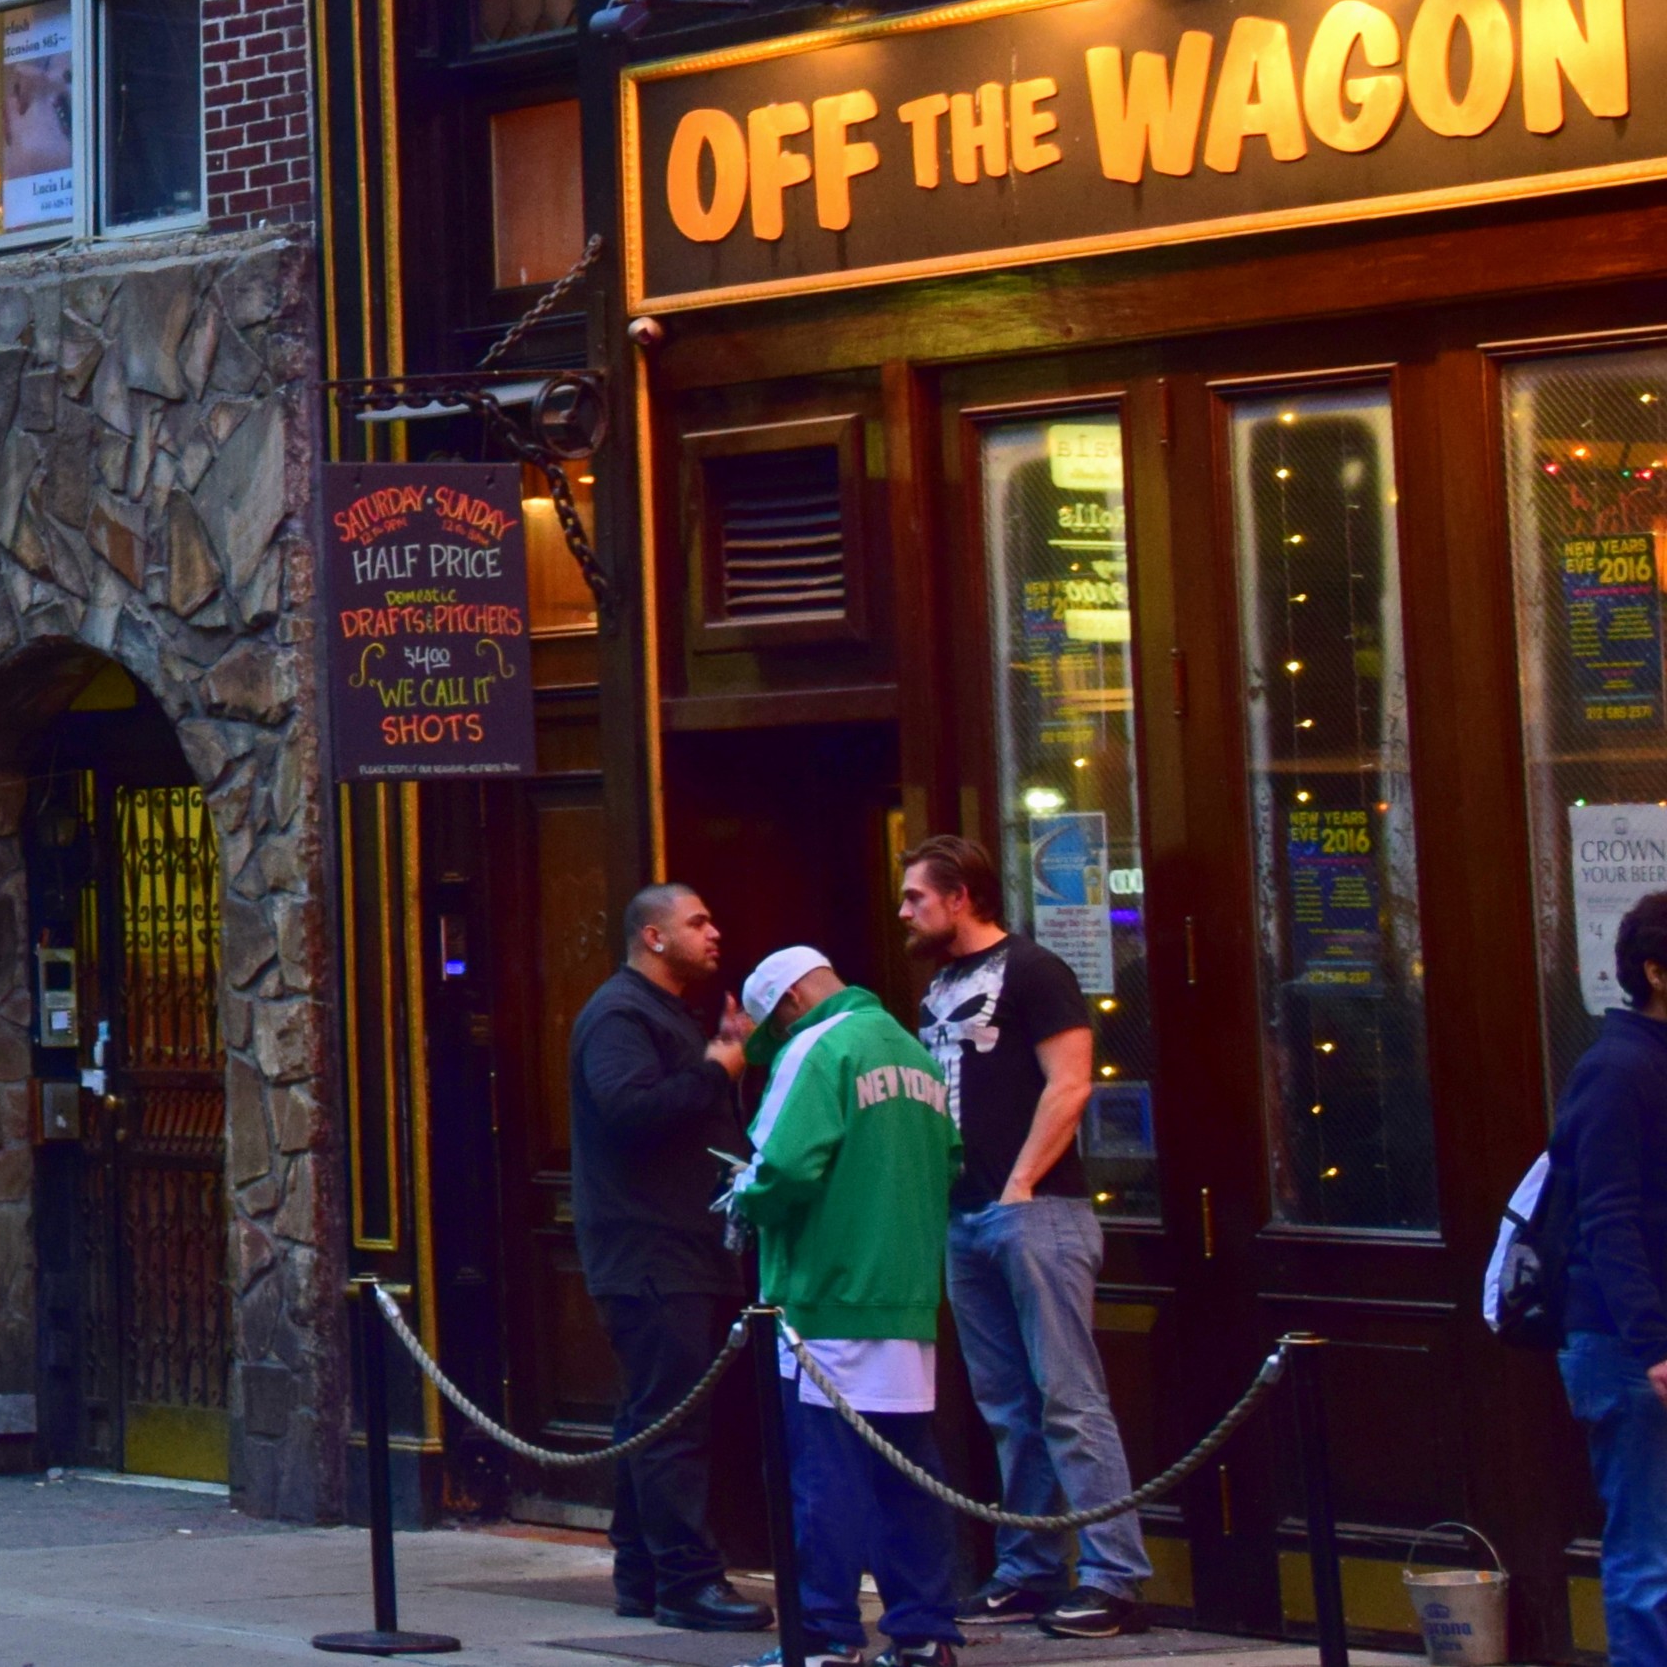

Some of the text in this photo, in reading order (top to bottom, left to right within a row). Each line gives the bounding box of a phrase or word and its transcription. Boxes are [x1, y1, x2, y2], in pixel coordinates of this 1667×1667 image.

[666, 89, 880, 243] OFF
[897, 76, 1063, 190] THE
[333, 484, 518, 543] SATURDAY SUNDAY
[1564, 537, 1648, 558] NEW YEARS
[352, 543, 503, 585] HALF PRICE
[1566, 556, 1652, 584] EVE 2016
[339, 604, 425, 639] DRAFTS
[434, 603, 524, 638] PITCHERS
[419, 676, 469, 708] CALL
[381, 713, 485, 746] SHOTS
[1288, 810, 1368, 826] NEW YEARS
[1290, 827, 1371, 854] EVE 2016
[1580, 839, 1667, 863] CROWN
[1581, 865, 1667, 884] YOUR BEER
